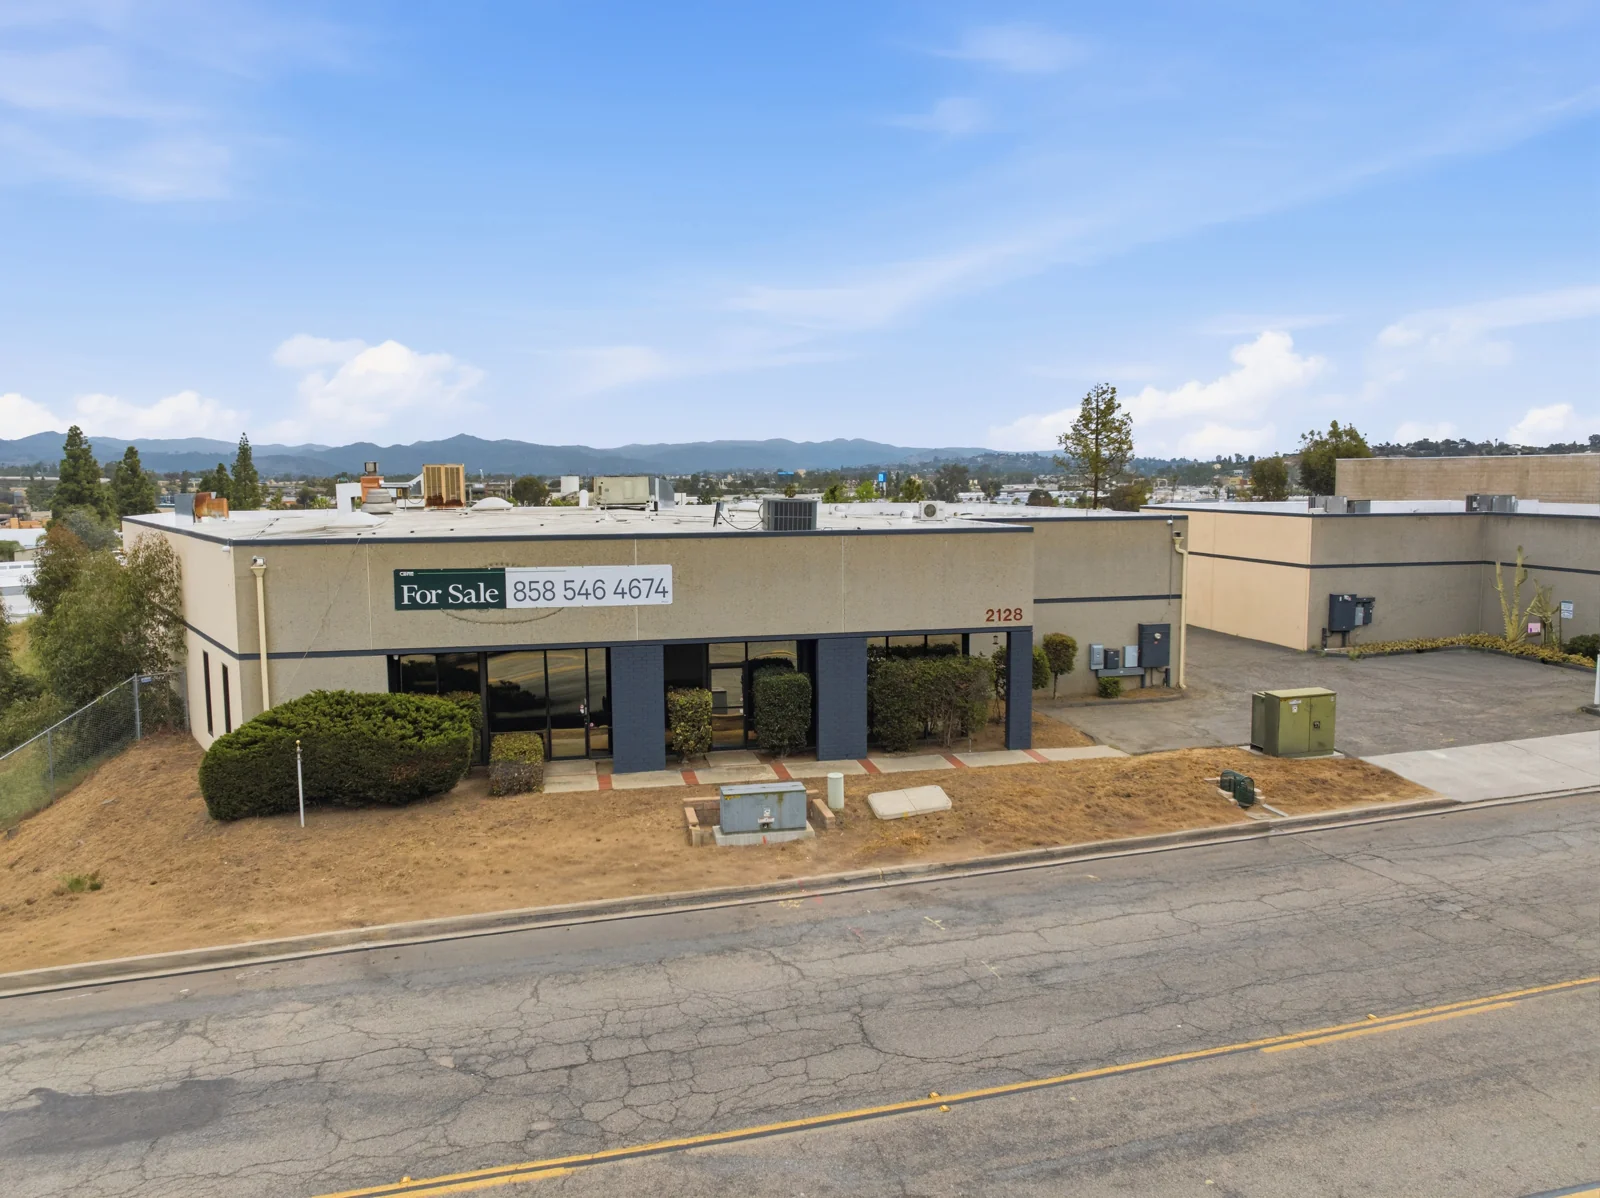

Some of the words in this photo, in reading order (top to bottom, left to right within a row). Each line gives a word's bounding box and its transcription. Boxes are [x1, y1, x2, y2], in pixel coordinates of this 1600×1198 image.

[401, 584, 442, 604] For
[448, 582, 500, 604] Sale
[513, 580, 556, 602] 858
[563, 579, 606, 601] 546
[612, 577, 669, 600] 4674
[985, 608, 1023, 622] 2128
